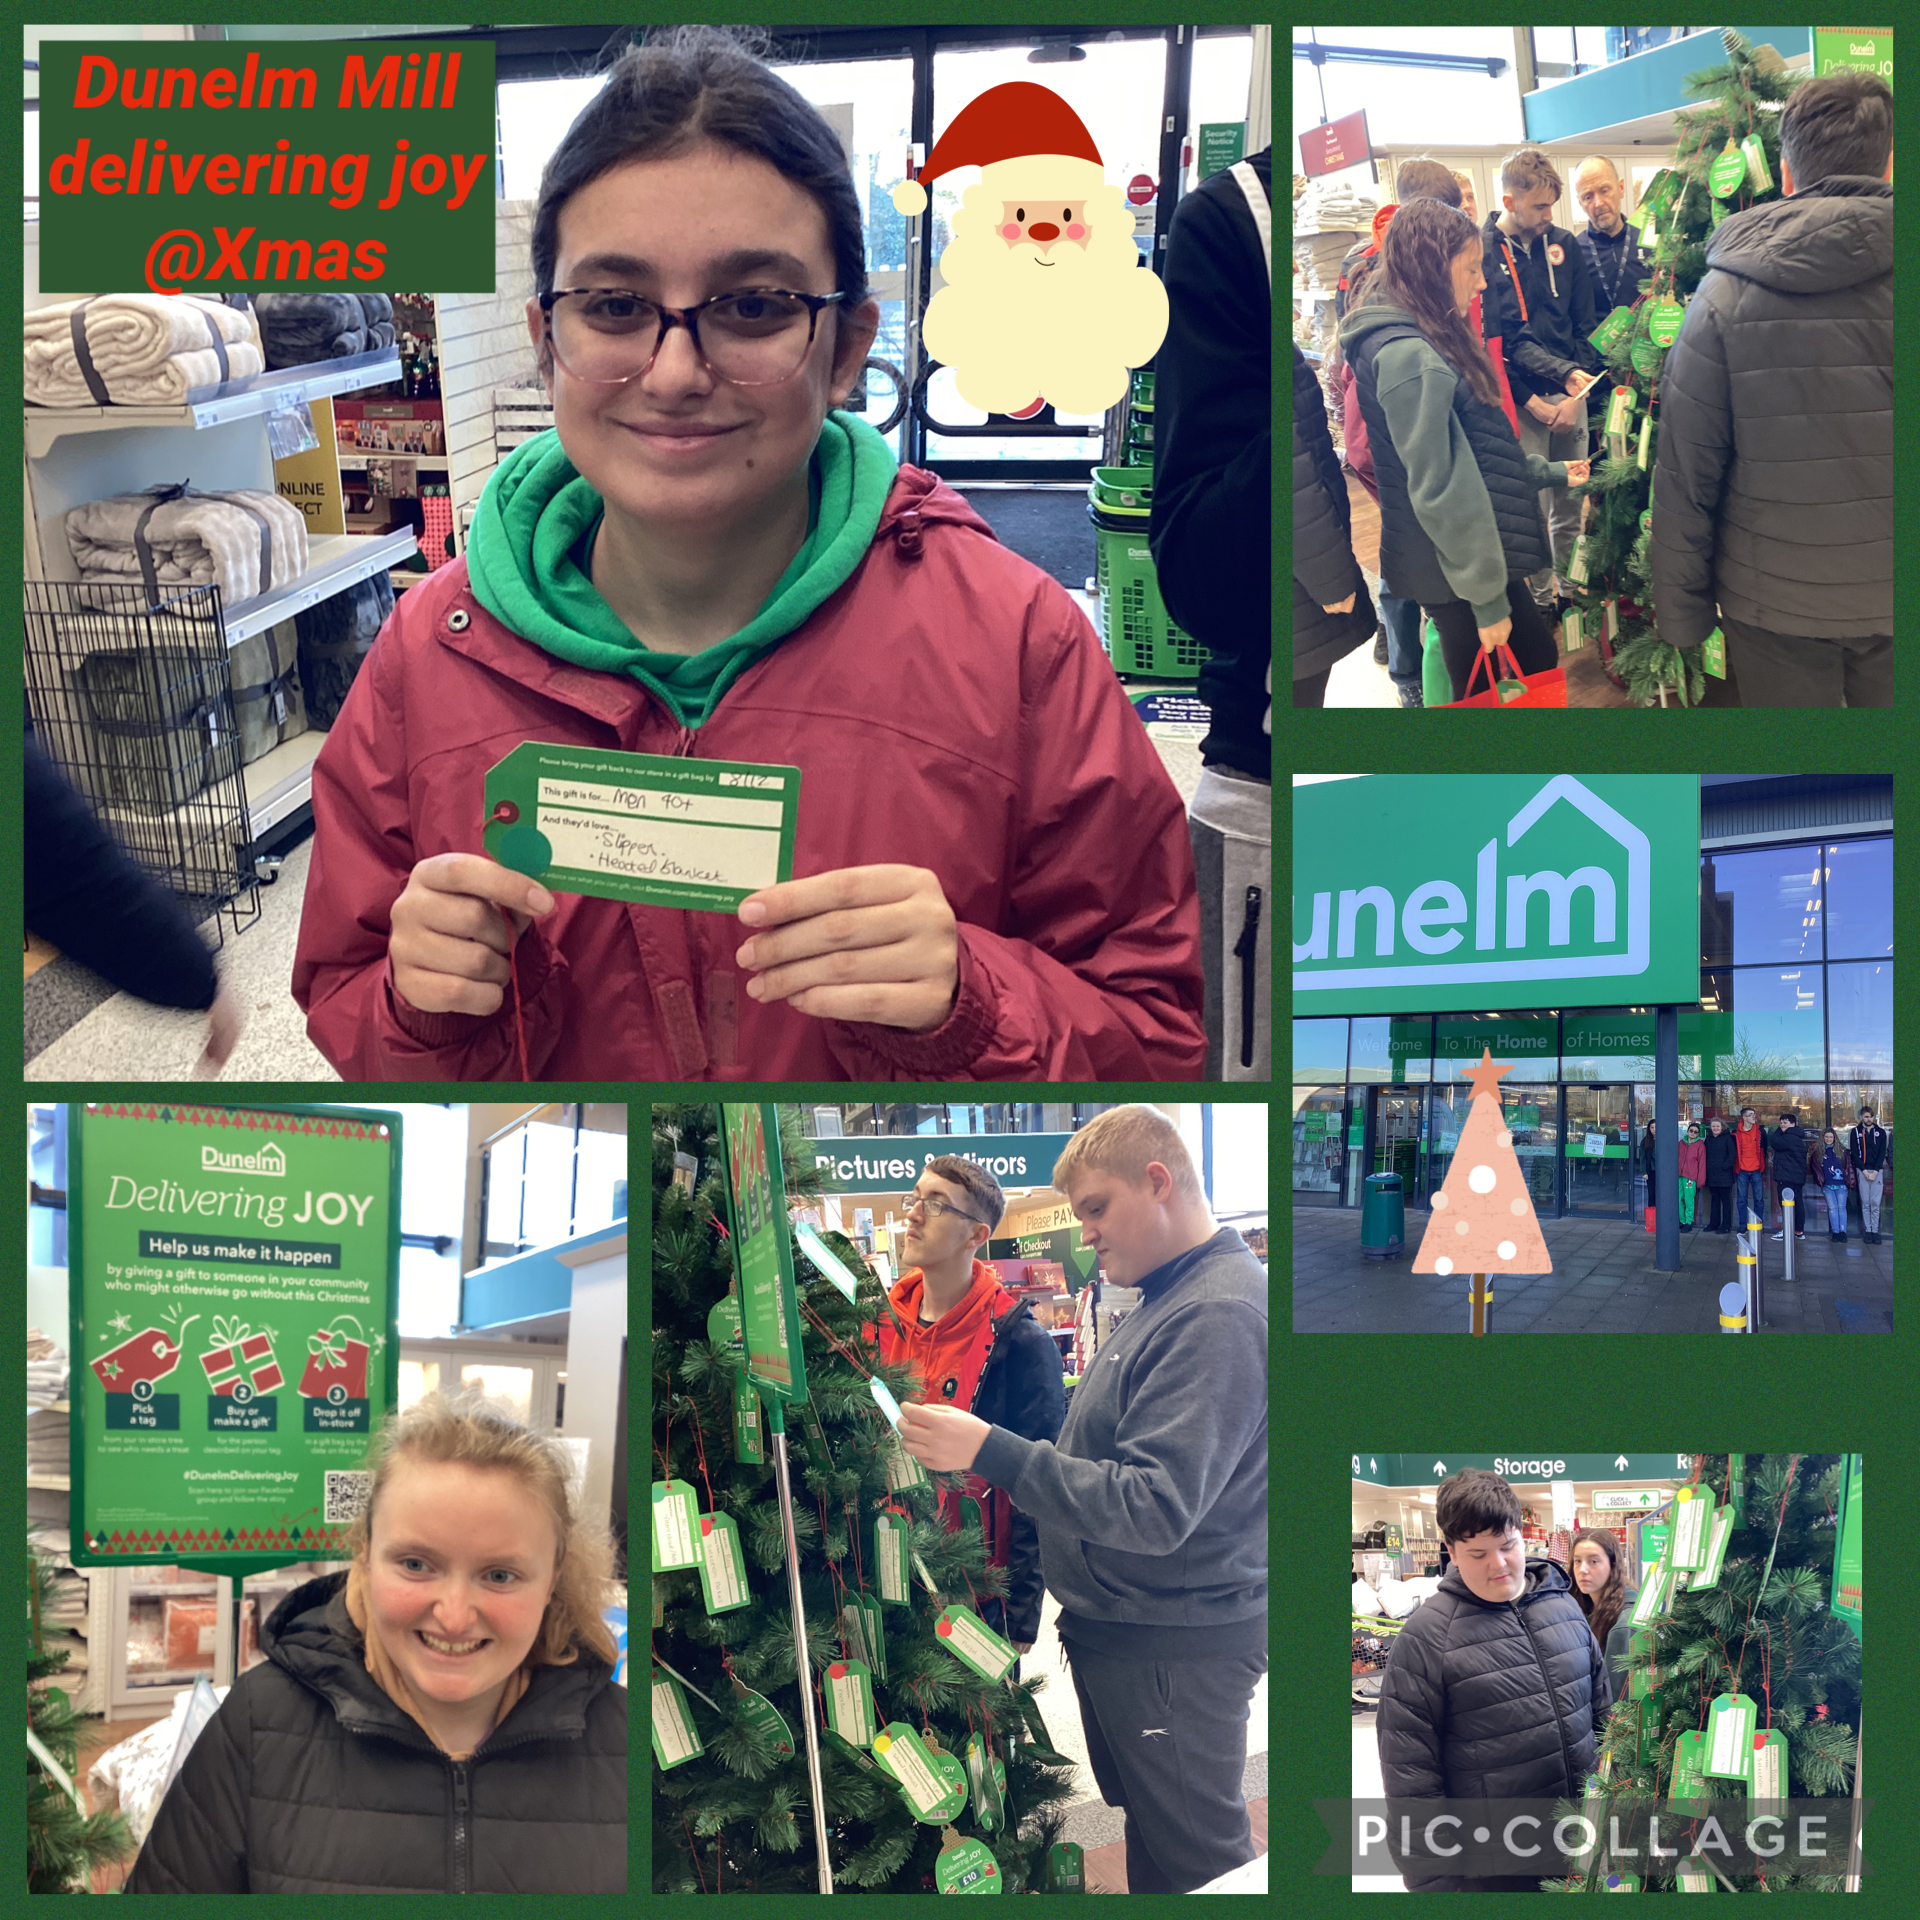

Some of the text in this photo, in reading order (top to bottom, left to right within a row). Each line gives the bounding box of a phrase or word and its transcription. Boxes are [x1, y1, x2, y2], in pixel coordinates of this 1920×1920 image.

[1850, 40, 1875, 55] Dunelm
[1205, 130, 1238, 138] Security
[277, 482, 325, 496] NLINE
[539, 756, 560, 765] Please
[561, 759, 579, 769] bring
[608, 765, 624, 773] back
[678, 773, 689, 781] gift
[691, 773, 704, 782] bag
[705, 774, 715, 783] by
[544, 786, 561, 796] This
[563, 789, 578, 799] gift
[579, 791, 587, 799] is
[542, 815, 590, 828] And they'd
[1357, 1030, 1650, 1052] Welcome To The Home of Homes
[1376, 1066, 1422, 1077] Entrance
[202, 1143, 284, 1174] Dunelm
[815, 1154, 916, 1180] Pictures
[949, 1152, 1027, 1175] irrors
[105, 1175, 374, 1227] Delivering JOY
[1026, 1207, 1073, 1231] Please PAY
[149, 1237, 332, 1267] Help us make it happen
[1024, 1238, 1051, 1253] Checkout
[106, 1262, 369, 1292] by giving a gift to someone in your community
[105, 1279, 370, 1304] who might otherwise go without this Christmas
[139, 1384, 341, 1400] 1 2 3
[132, 1403, 154, 1414] Pick
[227, 1405, 258, 1418] Buy or
[313, 1406, 361, 1419] Drop it off
[139, 1416, 157, 1428] tag
[214, 1416, 241, 1427] make
[319, 1418, 355, 1428] in-store
[1494, 1457, 1566, 1478] Storage
[183, 1469, 299, 1482] #DunelmDeliveringJoy
[1387, 1536, 1400, 1547] £14
[969, 1848, 981, 1861] JOY
[962, 1871, 977, 1886] £10
